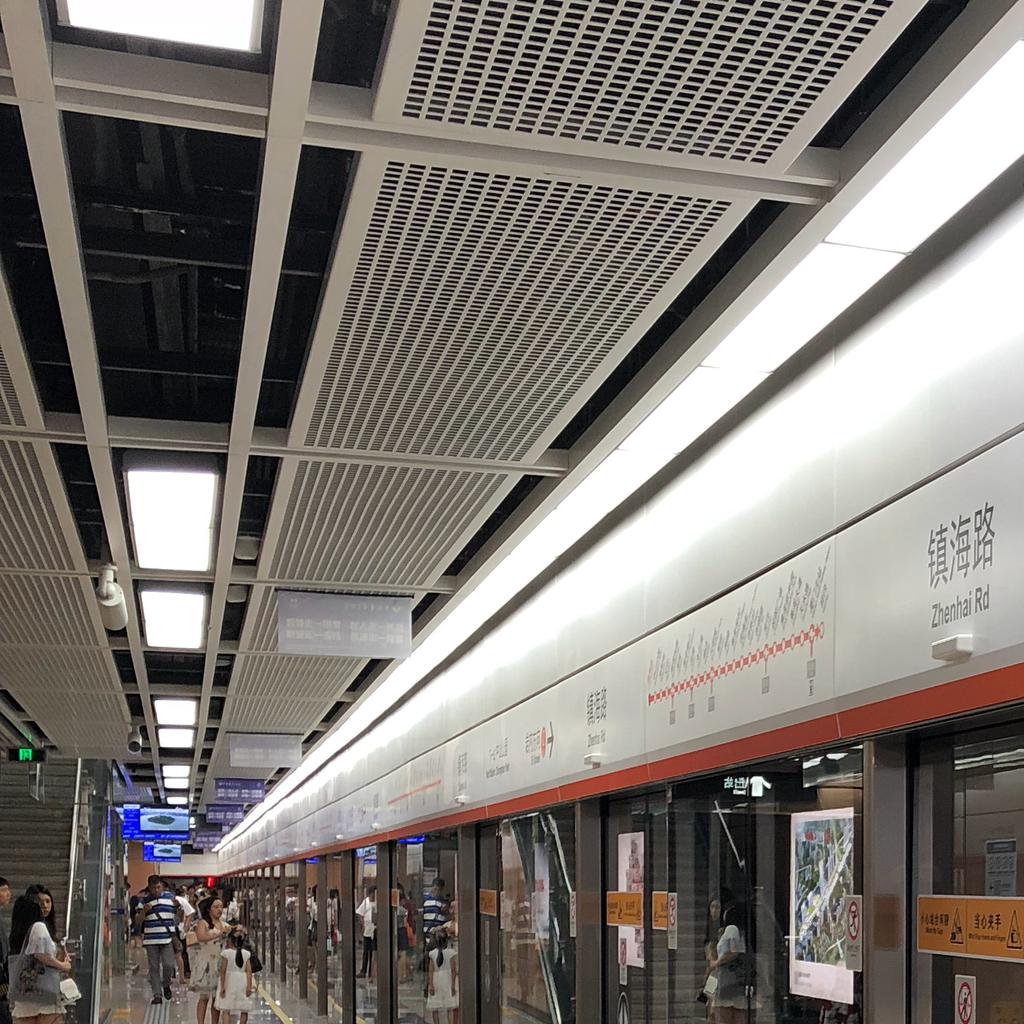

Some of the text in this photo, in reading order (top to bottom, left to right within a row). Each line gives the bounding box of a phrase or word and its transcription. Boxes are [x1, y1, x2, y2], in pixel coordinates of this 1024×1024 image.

[927, 502, 996, 588] 镇海路
[931, 583, 990, 628] Zhenhai Rd
[973, 912, 1002, 931] 当心夹手
